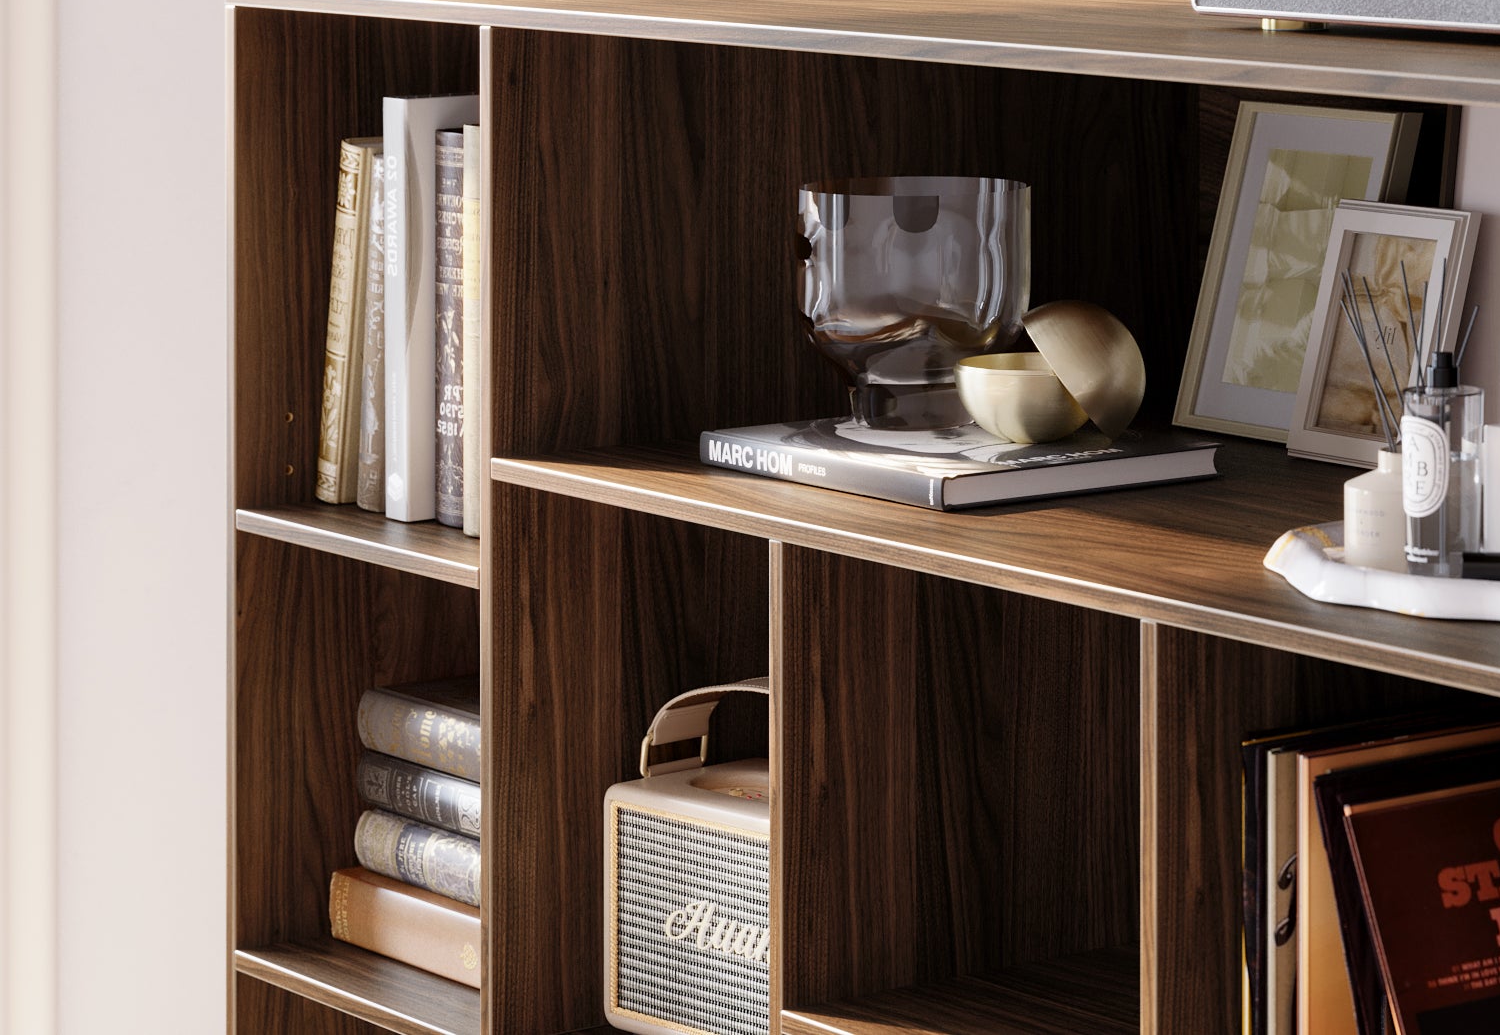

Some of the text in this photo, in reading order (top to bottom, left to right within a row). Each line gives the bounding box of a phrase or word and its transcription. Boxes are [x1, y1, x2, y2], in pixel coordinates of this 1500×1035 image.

[708, 439, 827, 477] MARC HOM PROFILES
